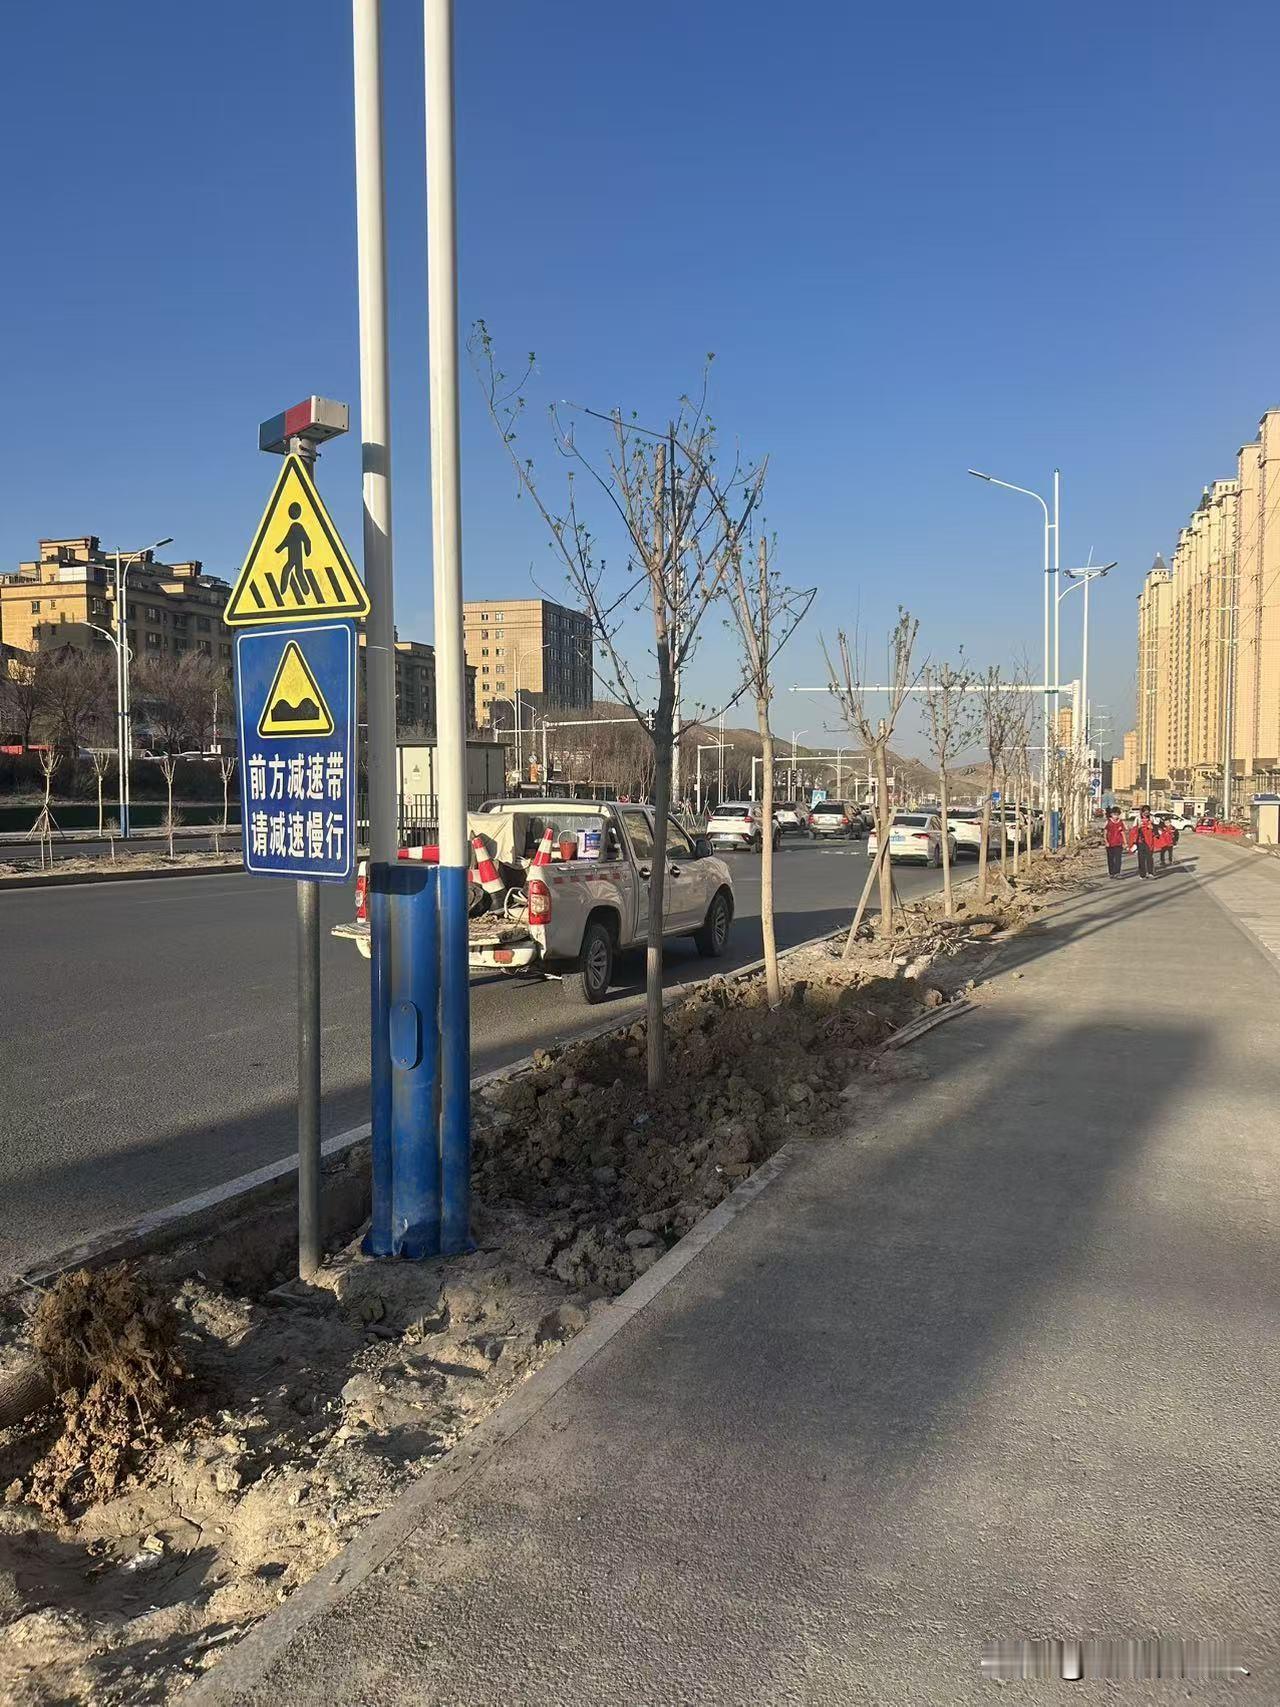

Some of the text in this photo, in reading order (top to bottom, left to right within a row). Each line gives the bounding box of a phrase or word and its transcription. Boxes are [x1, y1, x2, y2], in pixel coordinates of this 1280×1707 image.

[248, 751, 344, 801] 前方减速带
[251, 811, 344, 860] 请减速慢行
